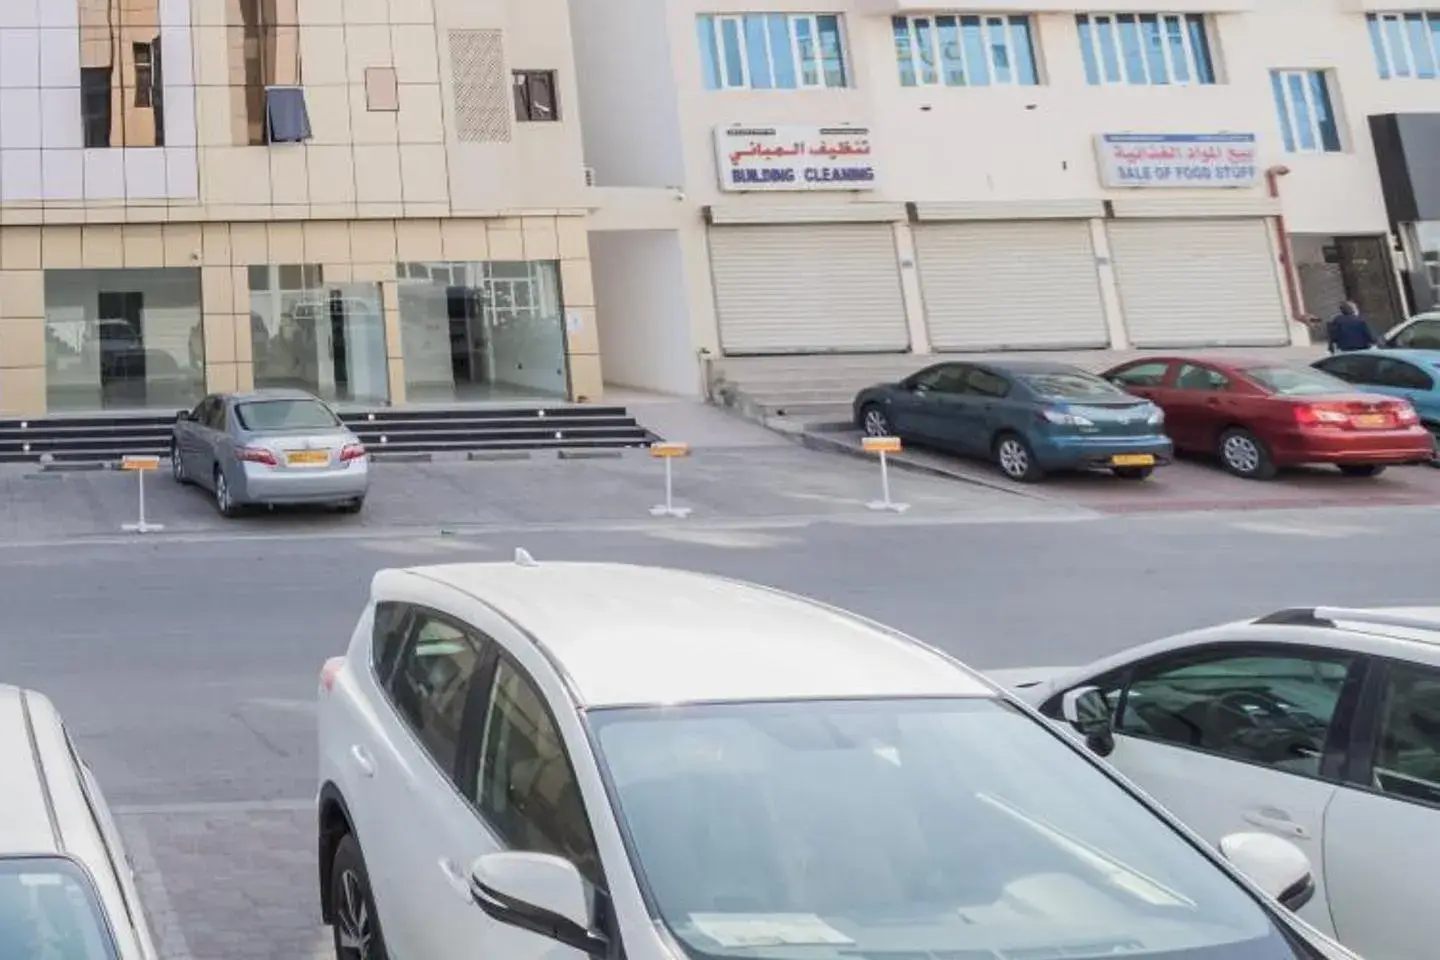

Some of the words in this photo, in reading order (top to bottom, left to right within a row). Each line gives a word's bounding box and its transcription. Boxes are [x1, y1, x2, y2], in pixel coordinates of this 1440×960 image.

[729, 141, 805, 166] المباني
[809, 140, 871, 159] تنظيف
[731, 167, 796, 183] BUILDING
[803, 166, 875, 182] CLEANING
[1118, 167, 1152, 180] SALE
[1155, 166, 1172, 180] OF
[1175, 167, 1212, 180] FOOD
[1215, 167, 1255, 180] STUFF
